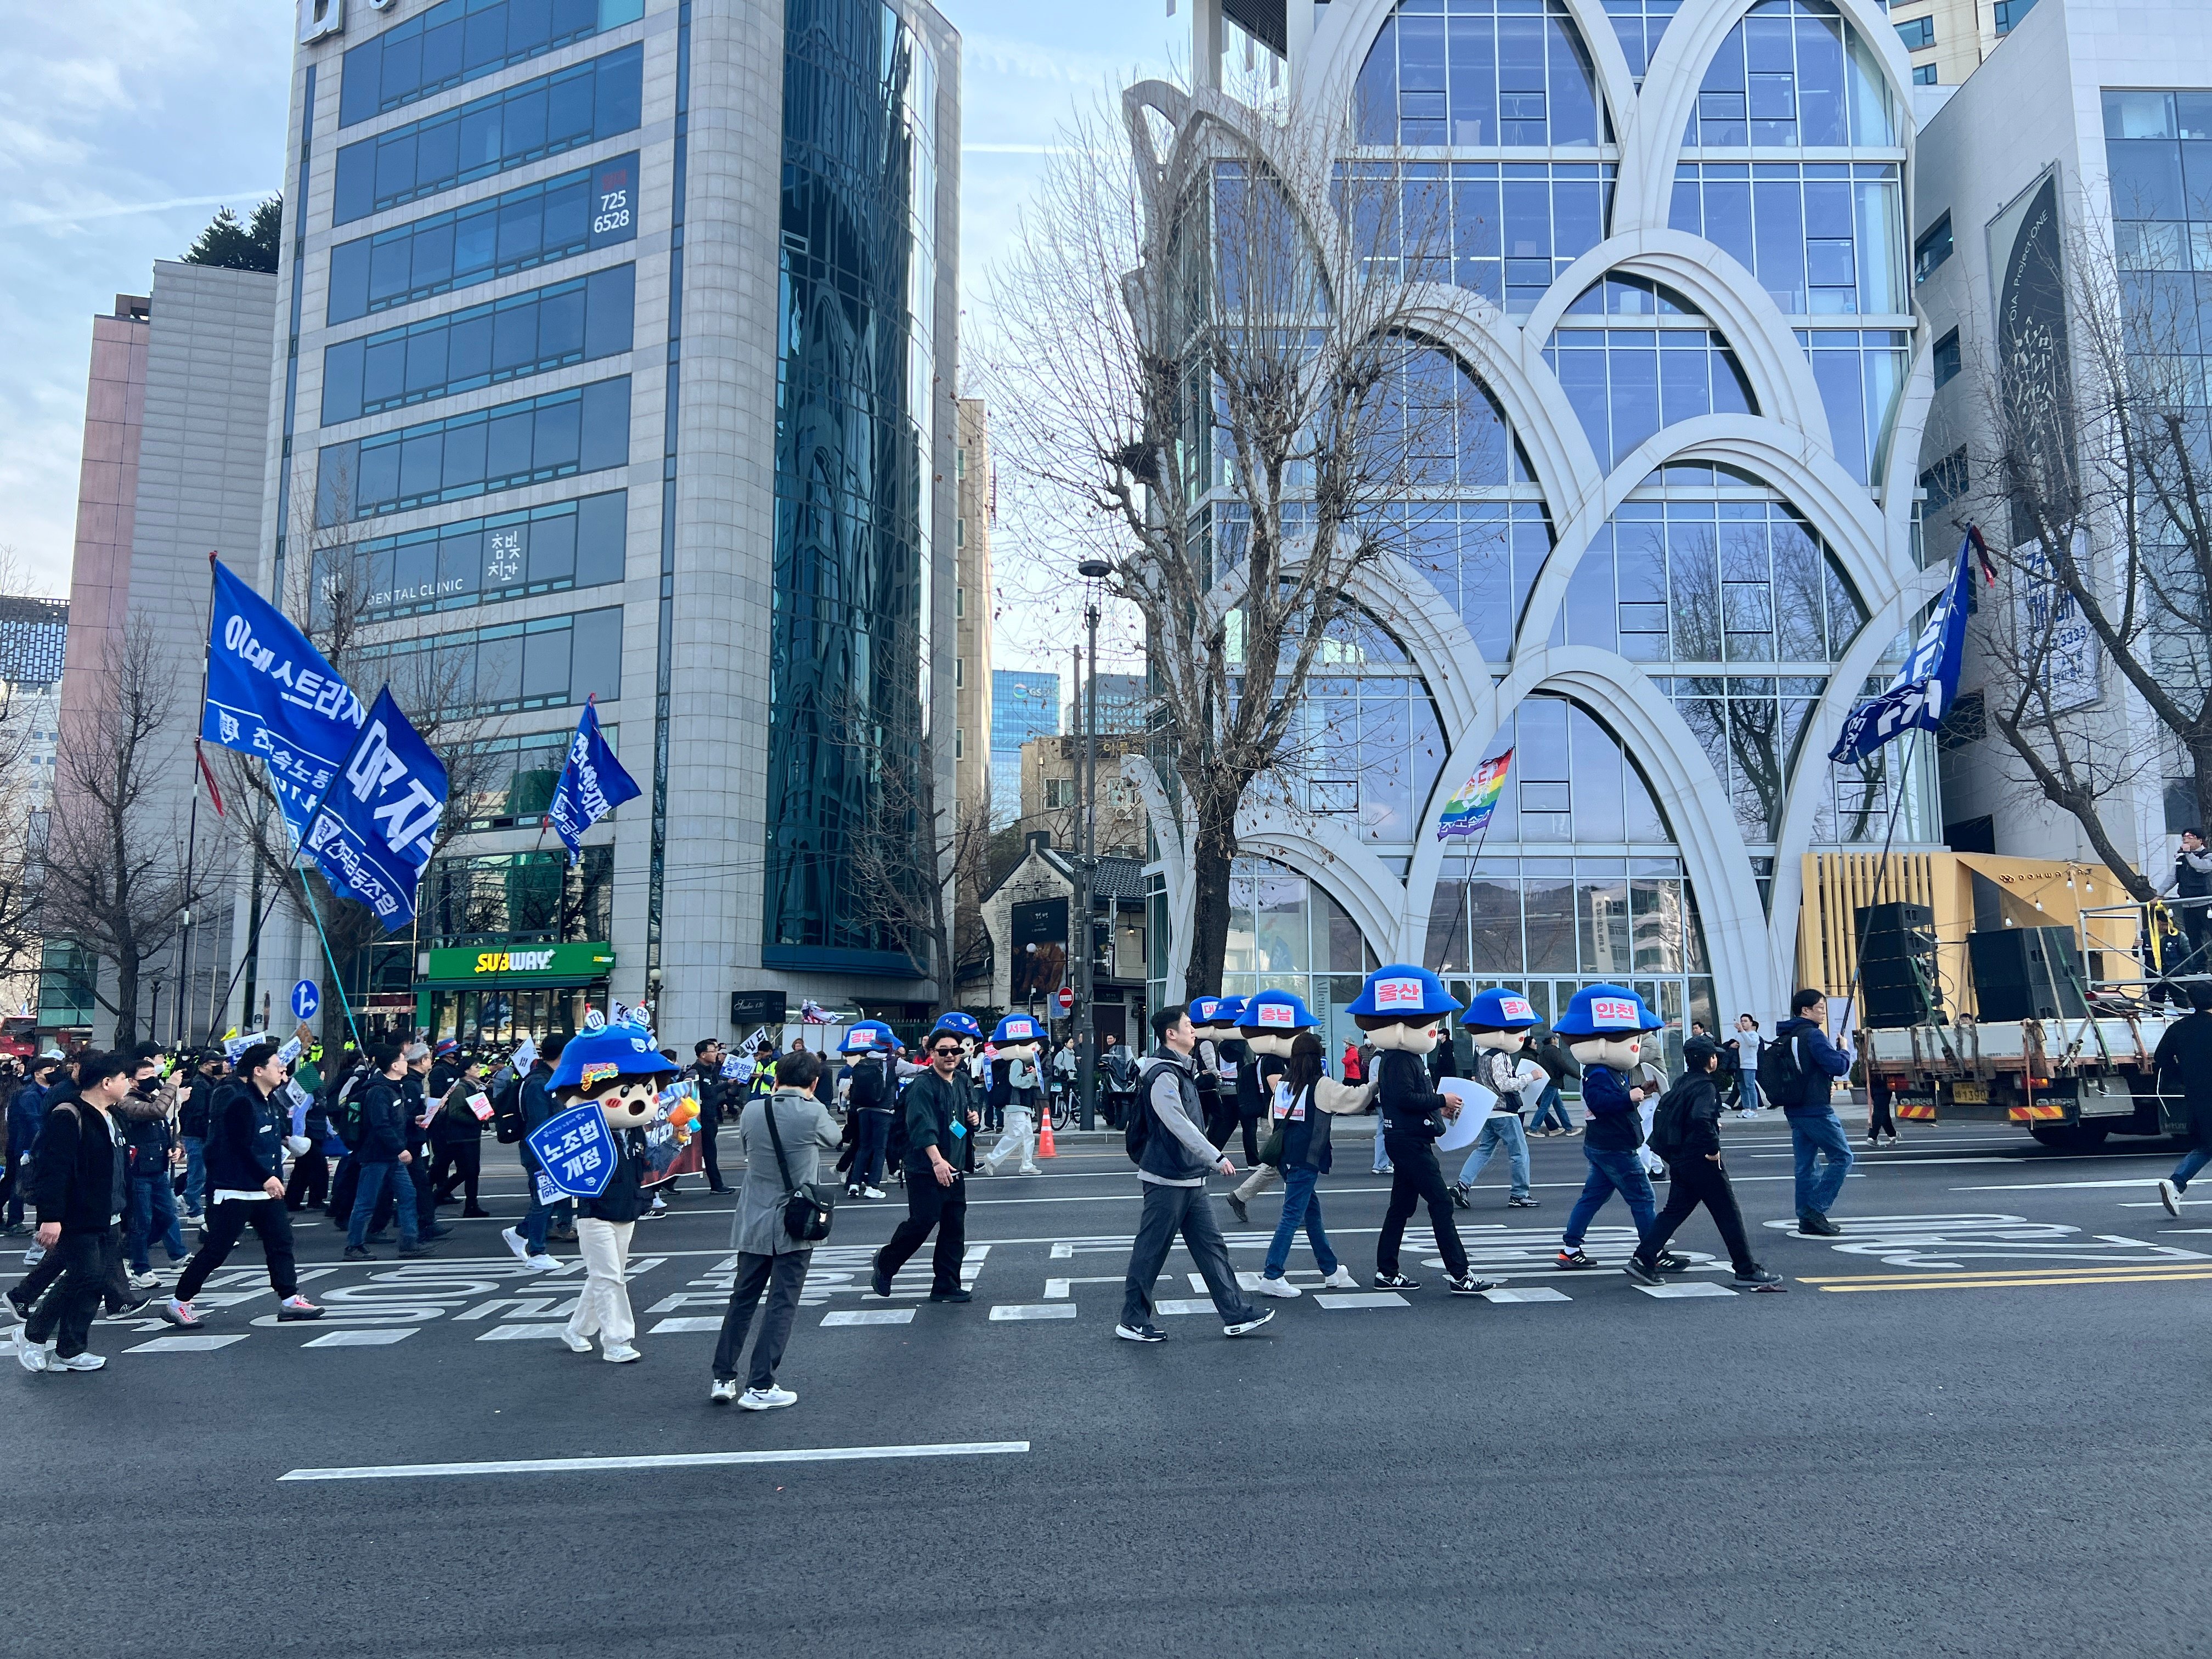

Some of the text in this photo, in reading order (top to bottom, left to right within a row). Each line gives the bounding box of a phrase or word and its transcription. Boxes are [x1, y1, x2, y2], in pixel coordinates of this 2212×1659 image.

[601, 190, 626, 212] 725
[594, 209, 629, 233] 6528
[2014, 240, 2032, 286] Project
[2030, 209, 2049, 239] ONE
[487, 561, 518, 582] 치과
[367, 578, 464, 606] DENTAL CLINIC
[2018, 871, 2062, 881] DOHWA
[475, 949, 556, 973] SUBWAY
[1378, 984, 1419, 1002] 울산
[1204, 1005, 1216, 1014] 대
[1261, 1008, 1291, 1021] 충남
[1504, 1001, 1531, 1014] 경기
[1595, 1003, 1635, 1020] 인천
[1008, 1023, 1030, 1034] 서울
[851, 1032, 874, 1043] 경남
[722, 1067, 751, 1080] 노동3권
[725, 1060, 753, 1074] 노동자의
[543, 1119, 600, 1164] 노조법
[562, 1146, 602, 1182] 개정
[1392, 1276, 1403, 1285] N
[1464, 1280, 1474, 1289] N
